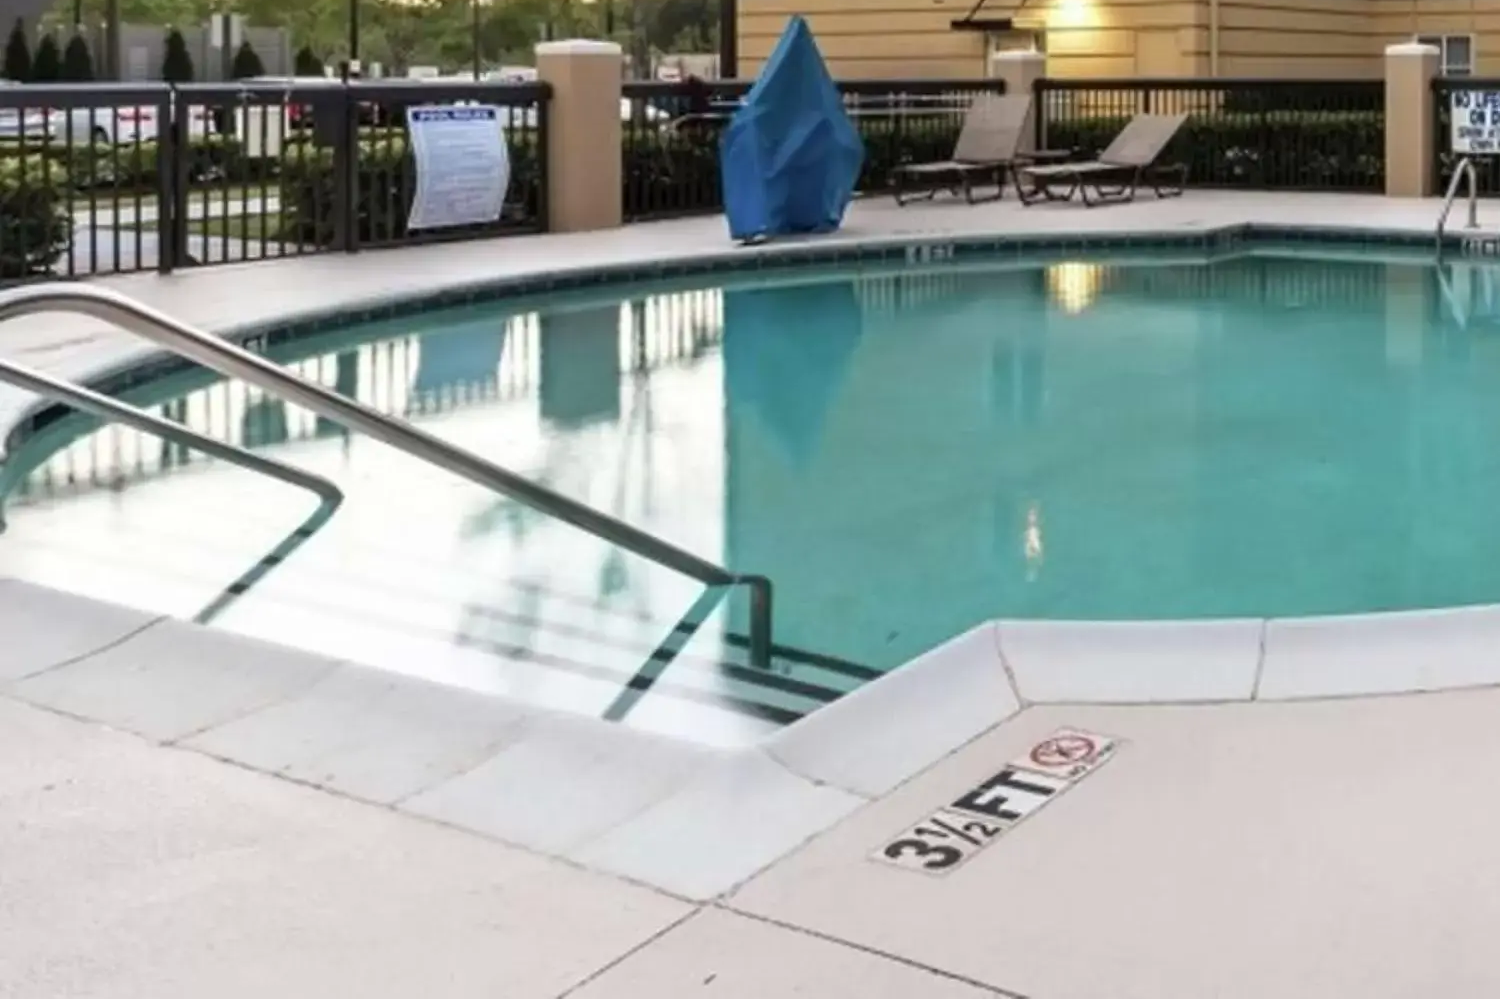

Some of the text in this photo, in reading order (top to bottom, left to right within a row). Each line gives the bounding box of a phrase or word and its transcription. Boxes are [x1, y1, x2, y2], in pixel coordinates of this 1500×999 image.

[1455, 91, 1470, 108] NO
[1470, 109, 1486, 125] ON
[1458, 127, 1483, 138] SWIM
[1488, 127, 1500, 138] AT
[1470, 140, 1494, 150] OWN
[951, 769, 1056, 821] FT
